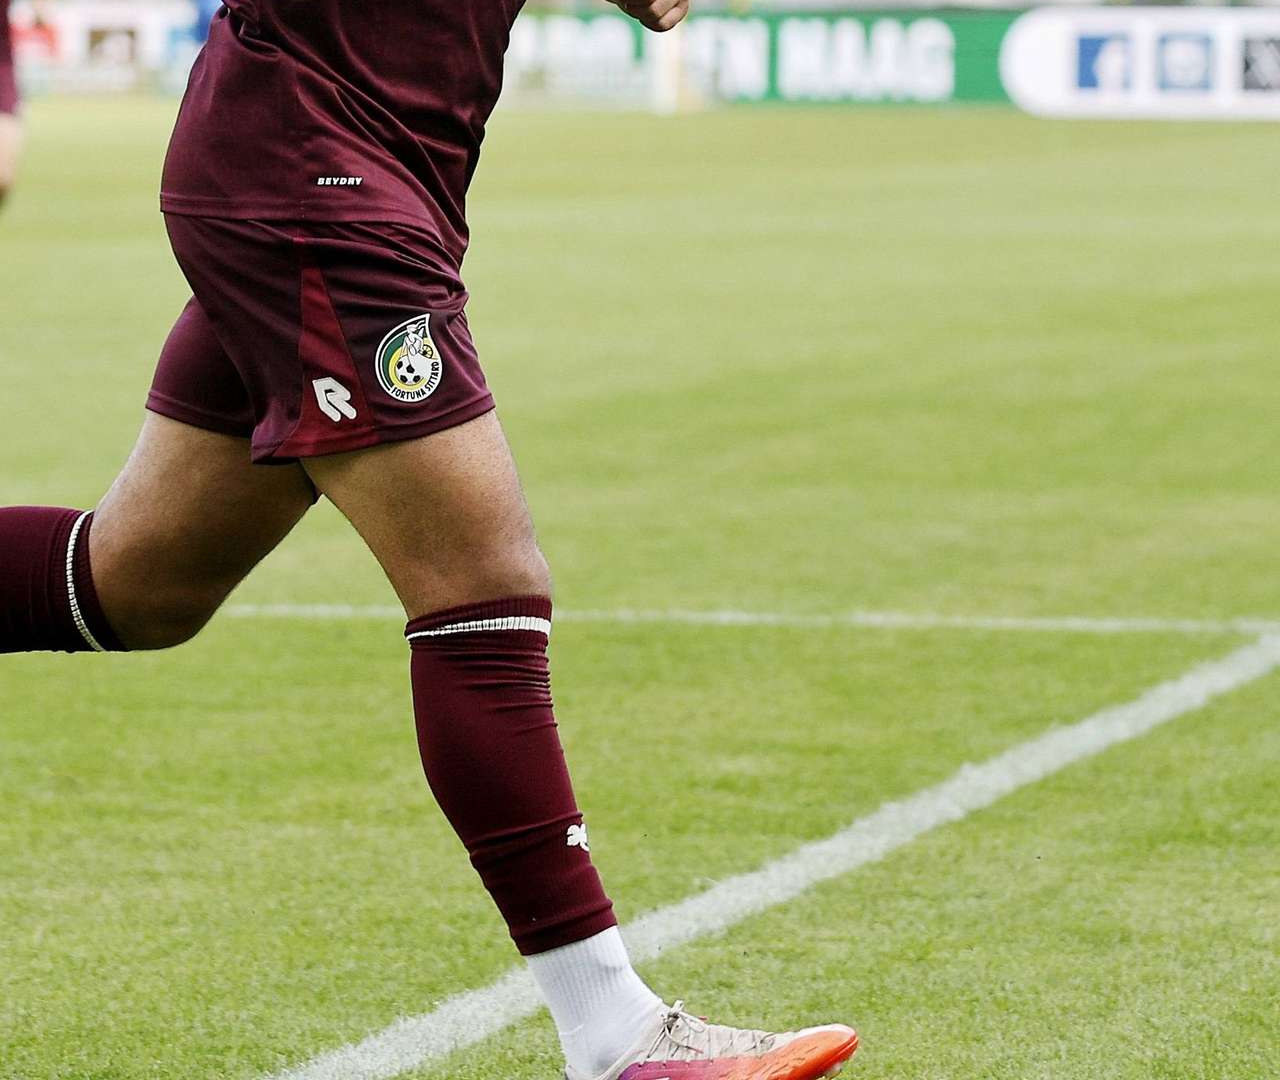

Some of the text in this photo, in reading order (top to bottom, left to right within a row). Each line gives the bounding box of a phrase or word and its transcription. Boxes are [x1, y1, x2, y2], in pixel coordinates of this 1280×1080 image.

[776, 18, 956, 102] HAAG
[391, 361, 440, 400] FORTUNA SITTARD
